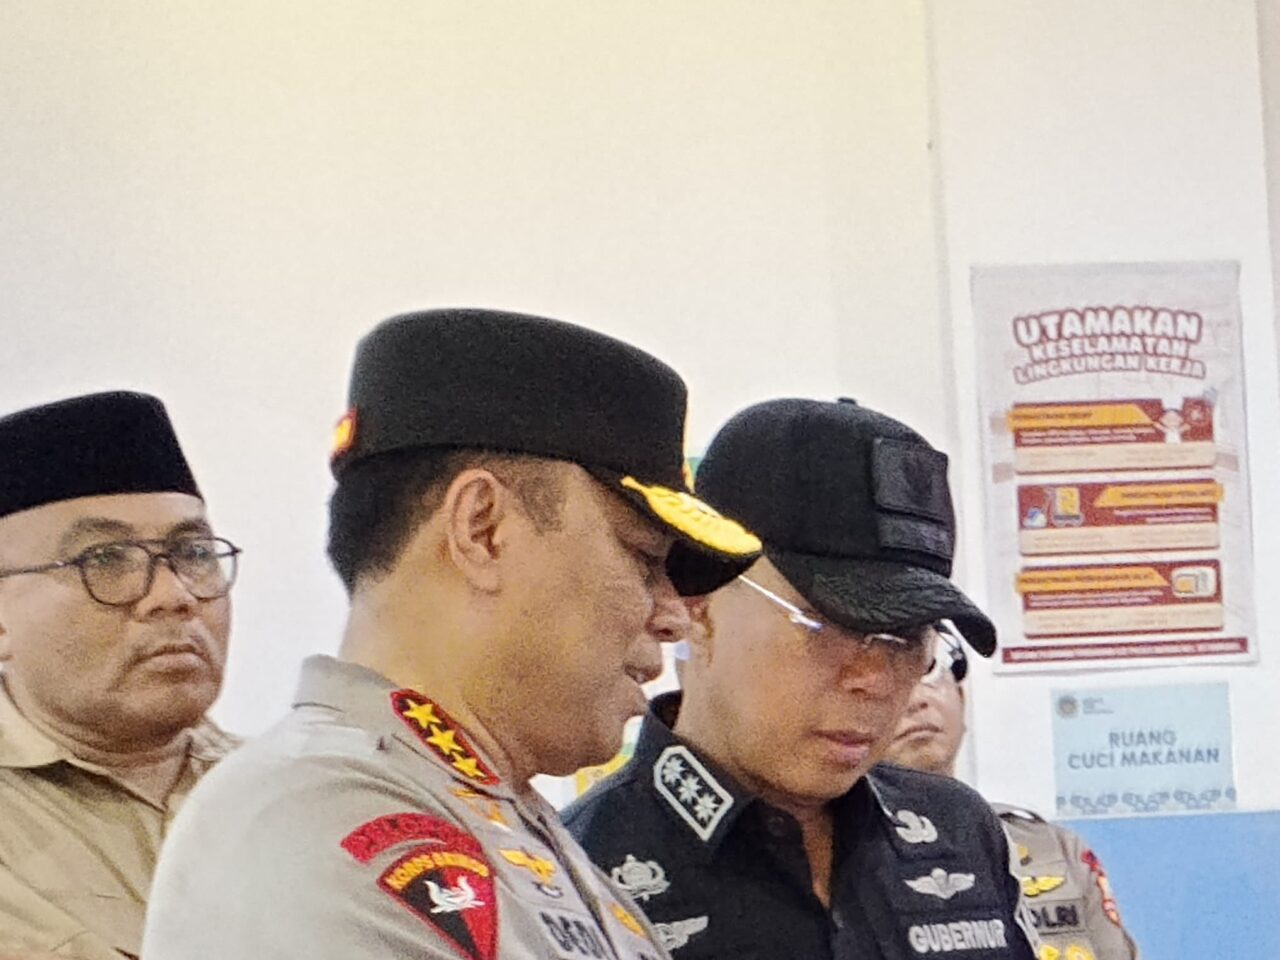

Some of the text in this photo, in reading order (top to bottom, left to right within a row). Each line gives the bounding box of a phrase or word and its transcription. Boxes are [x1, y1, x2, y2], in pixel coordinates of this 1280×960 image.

[1013, 306, 1203, 346] UTAMAKAN
[1030, 336, 1190, 363] KESELAMATAN
[1145, 357, 1206, 379] KERJA
[1109, 730, 1177, 748] RUANG
[1067, 748, 1220, 770] CUCI MAKANAN
[908, 918, 1008, 953] GUBERNUR
